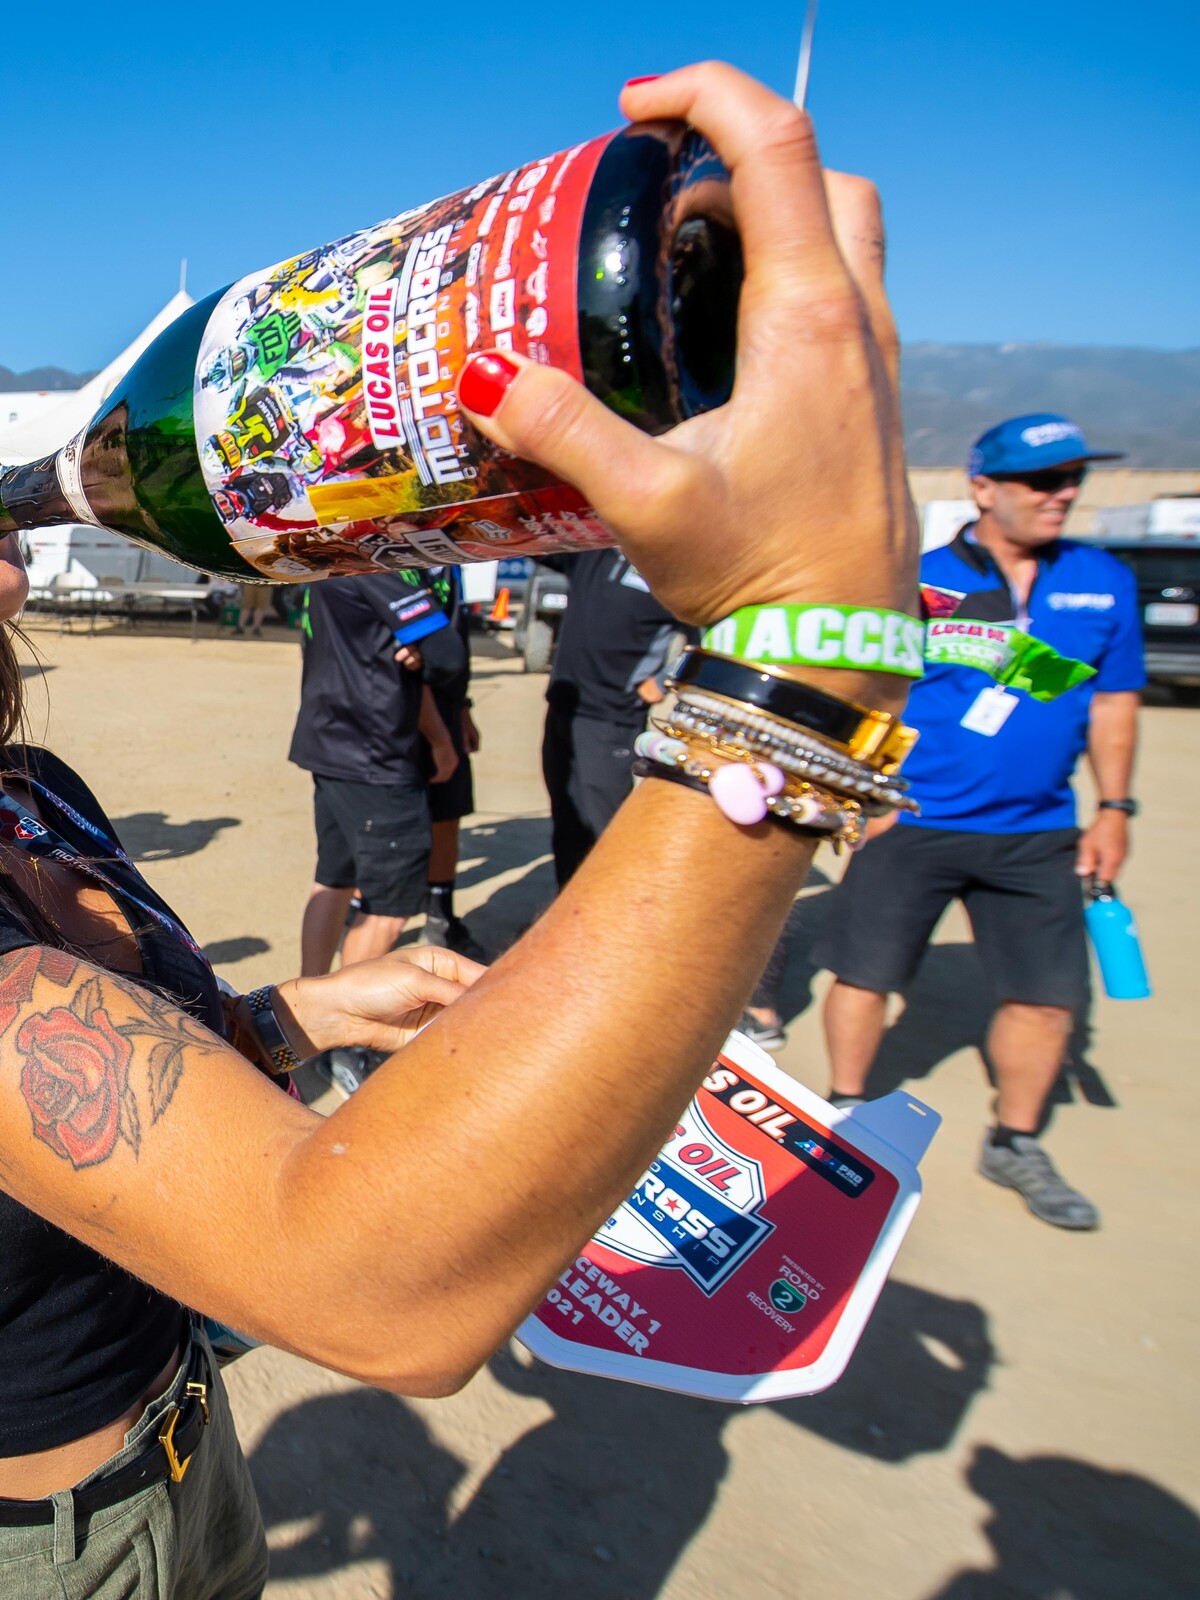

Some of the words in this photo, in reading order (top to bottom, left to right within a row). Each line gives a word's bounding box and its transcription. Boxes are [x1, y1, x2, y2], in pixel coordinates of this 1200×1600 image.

[366, 287, 393, 334] OIL
[254, 318, 282, 364] FOX
[394, 319, 410, 400] PRO
[407, 224, 465, 485] MOTOCROSS
[436, 219, 478, 479] CHAMPIONSHIP
[366, 341, 400, 438] LUCAS
[257, 400, 280, 439] SUZUKI
[702, 1067, 740, 1093] S
[729, 1089, 798, 1140] OIL
[678, 1143, 743, 1191] OIL
[838, 1165, 864, 1185] PRO
[575, 1256, 648, 1318] CEWAY
[647, 1319, 662, 1335] 1
[778, 1264, 820, 1300] ROAD
[781, 1254, 817, 1284] PRESENTED
[815, 1282, 826, 1291] BY
[546, 1288, 585, 1326] 021
[559, 1267, 650, 1356] LEADER
[746, 1291, 797, 1334] RECOVERY
[774, 1290, 794, 1309] 2
